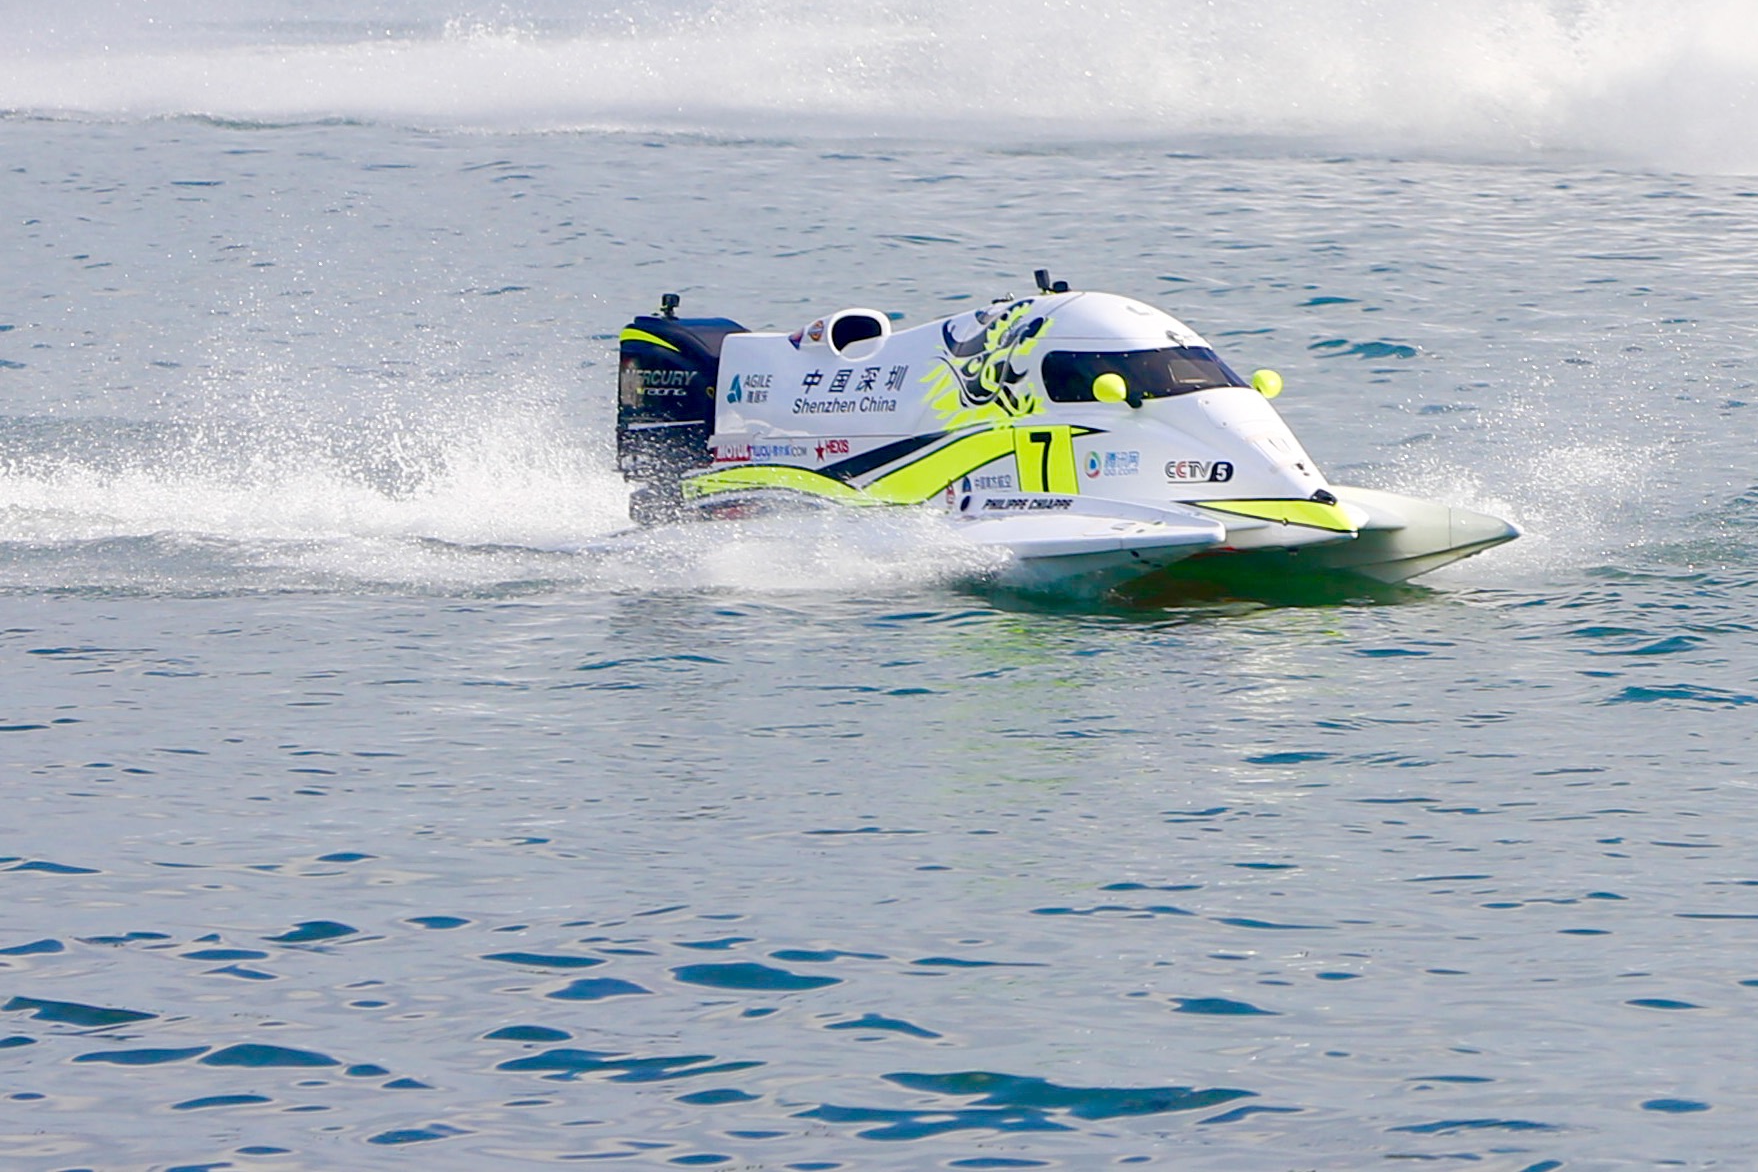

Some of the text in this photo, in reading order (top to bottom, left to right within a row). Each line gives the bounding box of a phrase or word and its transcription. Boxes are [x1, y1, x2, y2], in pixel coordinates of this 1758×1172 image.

[744, 375, 772, 388] AGILE
[801, 365, 908, 395] 中国深圳
[792, 396, 897, 414] Shenzhen China
[1030, 432, 1052, 492] 7
